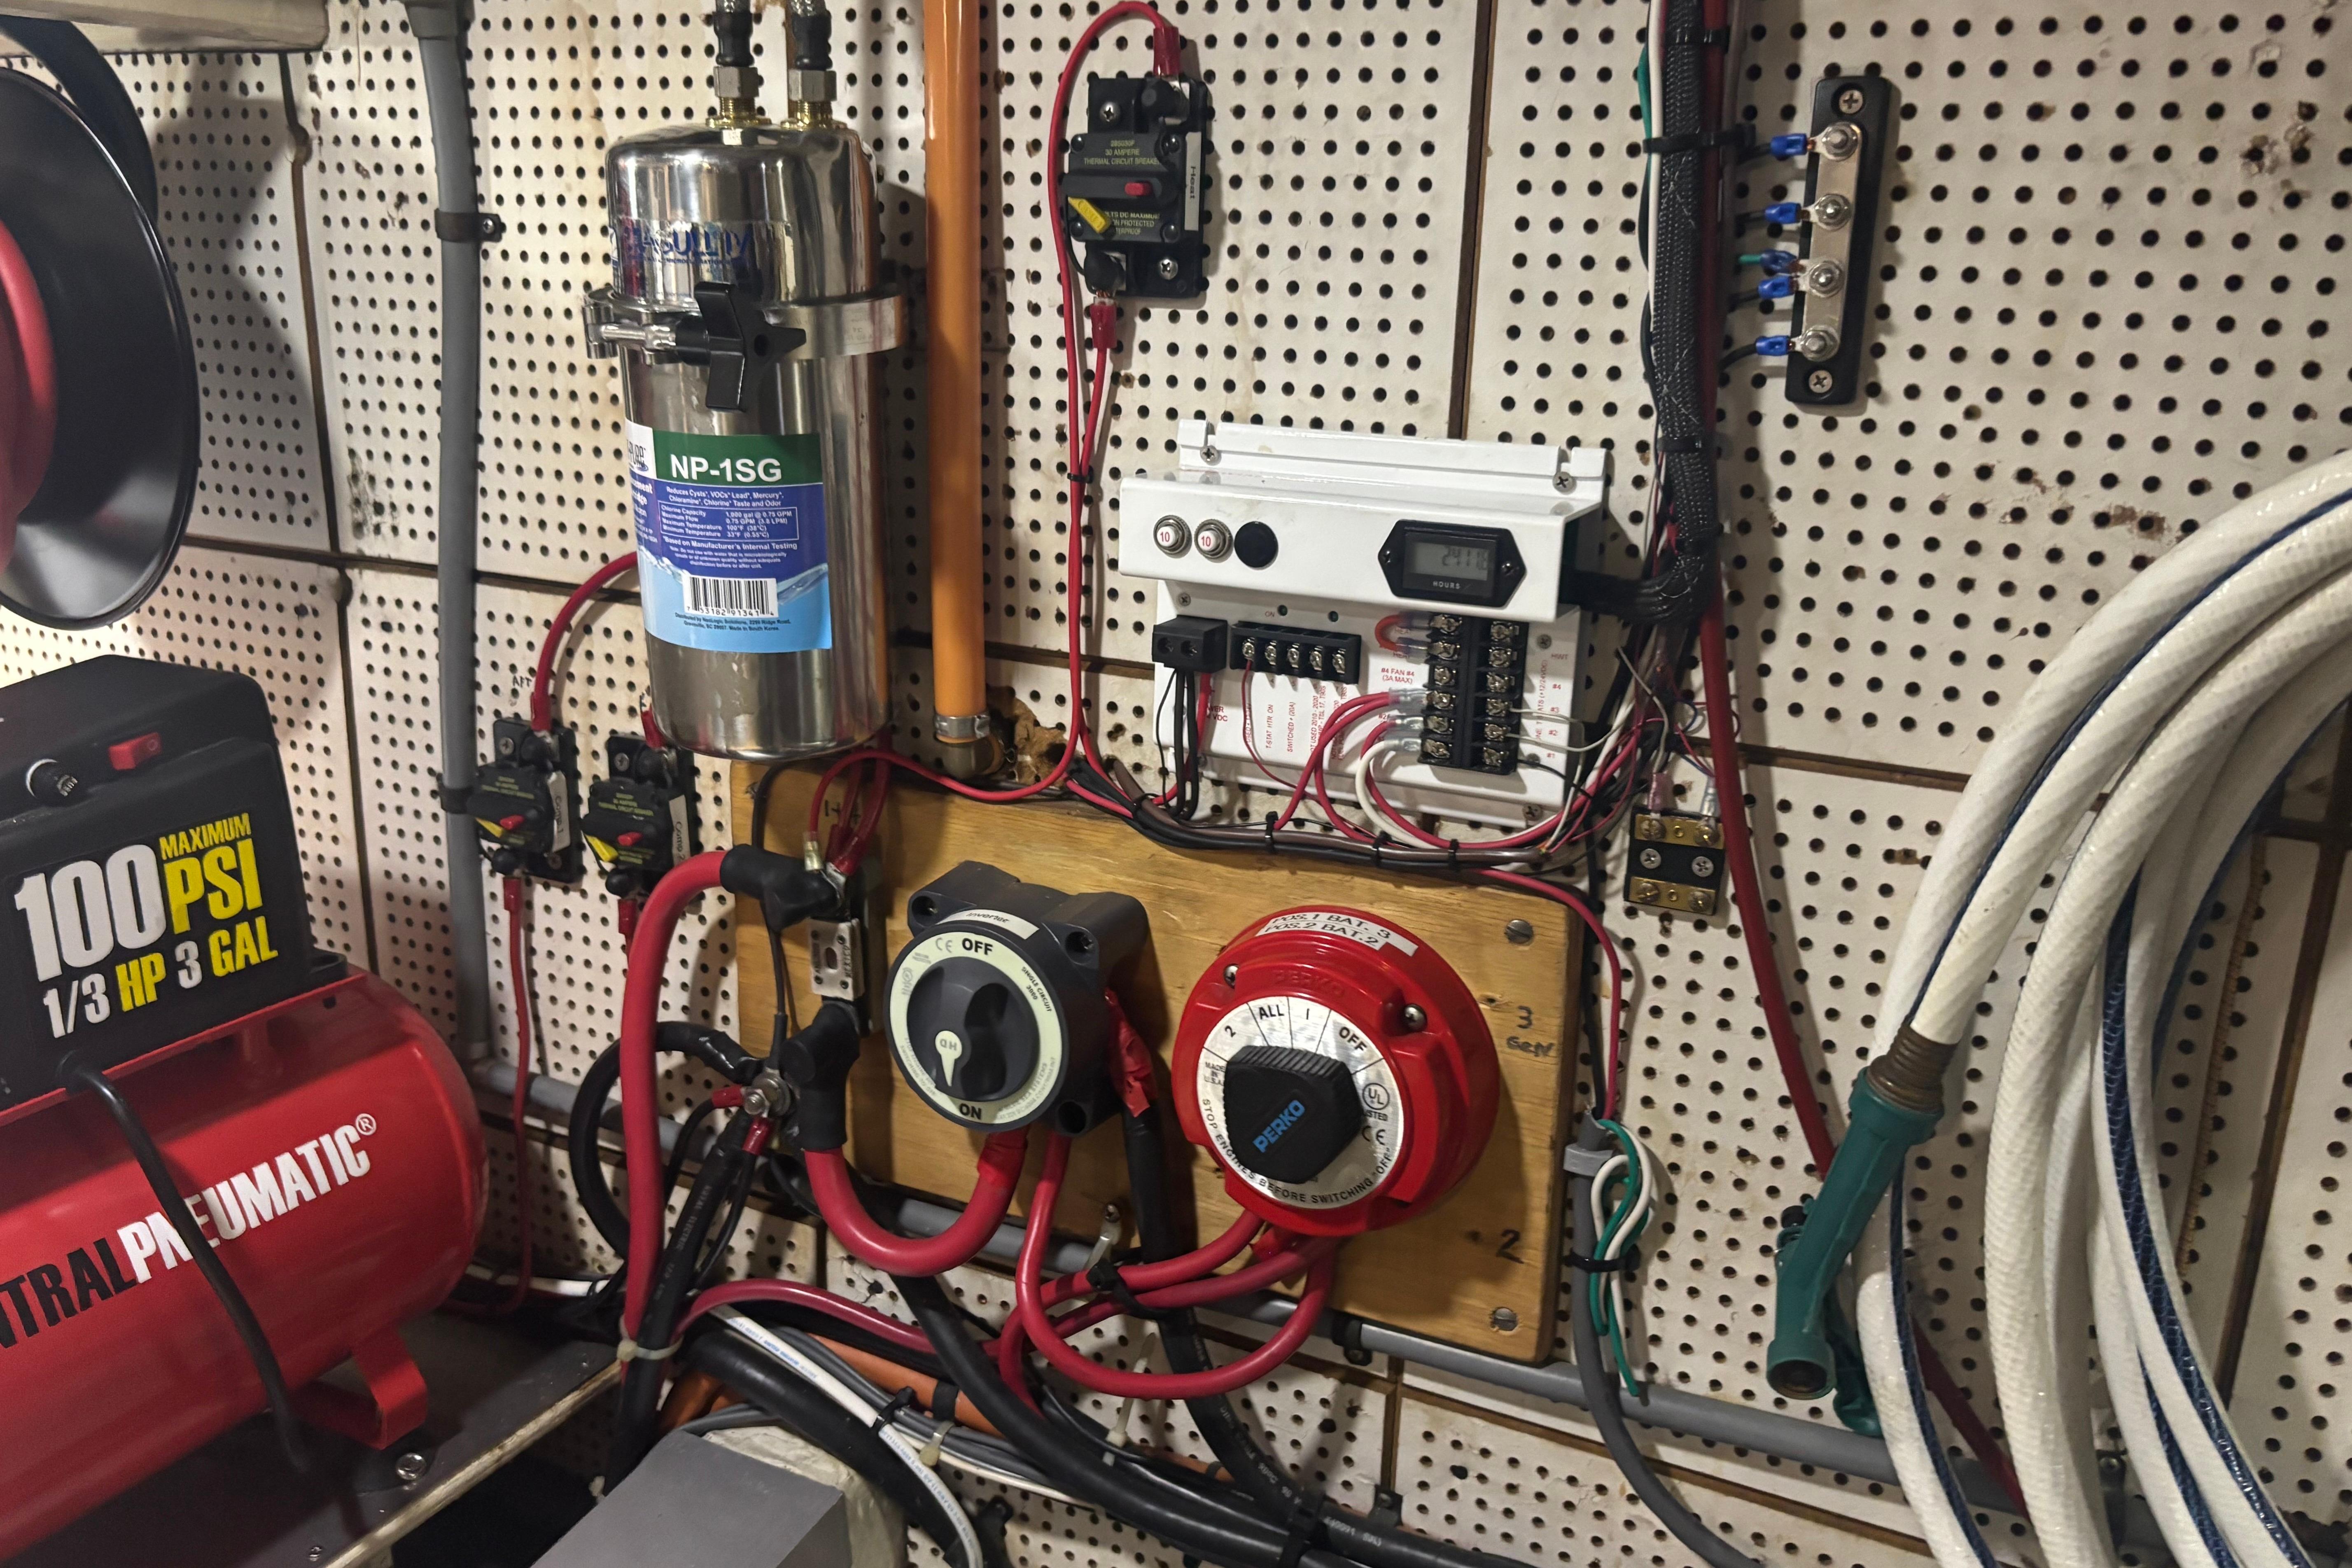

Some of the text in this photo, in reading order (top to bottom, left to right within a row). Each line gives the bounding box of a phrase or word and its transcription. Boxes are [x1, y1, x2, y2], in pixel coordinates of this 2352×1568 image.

[670, 454, 782, 483] NP-1SG
[666, 486, 688, 496] Reduces
[661, 505, 681, 513] Chlorine
[662, 511, 684, 521] Maximum
[662, 518, 685, 527] Maximum
[686, 522, 722, 531] Temperature
[663, 525, 684, 534] Minimum
[686, 529, 721, 537] Temperature
[692, 539, 741, 550] Manufacturer's
[1160, 532, 1170, 542] 10
[1201, 536, 1211, 547] 10
[1433, 581, 1461, 589] HOURS
[700, 607, 726, 616] 53182
[1268, 704, 1273, 713] ON
[160, 813, 252, 860] MAXIMUM
[14, 838, 263, 982] 100 PSI
[1377, 929, 1391, 940] 3
[961, 937, 993, 955] OFF
[43, 915, 278, 1038] 1/3 HP 3 GAL
[1022, 966, 1052, 1012] SINGLE CIRCUIT
[1259, 1004, 1284, 1020] ALL
[1517, 1006, 1533, 1029] 3
[1224, 1025, 1237, 1038] 2
[1339, 1026, 1367, 1052] OFF
[1368, 1087, 1385, 1106] UL
[959, 1103, 982, 1120] ON
[1253, 1099, 1306, 1153] PERKO
[1203, 1099, 1218, 1130] STOP
[1216, 1135, 1256, 1180] ENGINES
[1259, 1176, 1306, 1203] BEFORE
[1312, 1175, 1374, 1204] SWITCHING
[1495, 1229, 1525, 1265] 2
